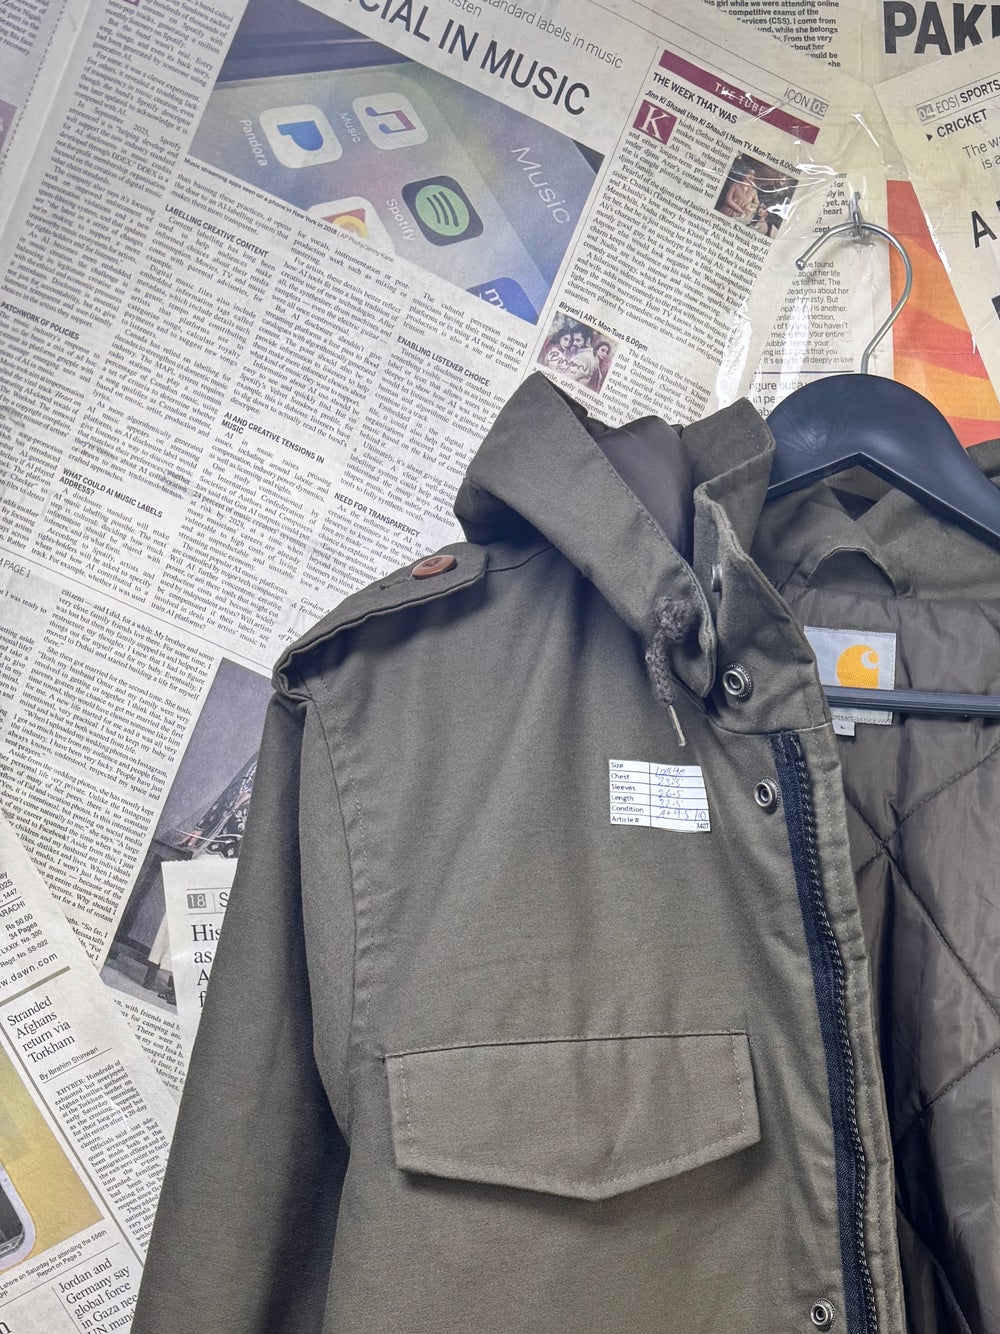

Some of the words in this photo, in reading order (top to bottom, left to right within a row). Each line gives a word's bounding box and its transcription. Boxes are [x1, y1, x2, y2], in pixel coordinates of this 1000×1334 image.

[535, 14, 572, 43] labels
[572, 32, 585, 49] in
[585, 42, 624, 69] music
[774, 26, 795, 34] while
[795, 26, 809, 34] she
[809, 26, 839, 35] belongs
[438, 18, 480, 62] IN
[479, 39, 590, 116] MUSIC
[652, 71, 671, 88] THE
[670, 81, 696, 102] WEEK
[696, 95, 720, 114] THAT
[718, 107, 738, 124] WAS
[341, 112, 361, 144] Music
[936, 107, 987, 138] CRICKET
[238, 118, 269, 168] Pandora
[510, 146, 570, 224] Music
[164, 203, 203, 227] LABELLING
[202, 222, 236, 243] CREATIVE
[235, 237, 269, 258] CONTENT
[386, 197, 415, 241] Spotify
[971, 210, 998, 249] A
[58, 475, 95, 496] ADDRESS?
[62, 467, 83, 481] WHAT
[82, 476, 106, 492] COULD
[105, 487, 114, 496] AI
[113, 490, 137, 506] MUSIC
[136, 501, 163, 519] LABELS
[611, 772, 630, 780] Chest
[612, 783, 636, 792] Sleeves
[612, 795, 634, 803] Length
[612, 805, 644, 813] Condition
[6, 996, 53, 1027] Stranded
[16, 1011, 58, 1040] Afghans
[22, 1030, 53, 1052] return
[52, 1021, 72, 1034] via
[27, 1035, 76, 1063] Torkham
[58, 1271, 93, 1294] Jordan
[92, 1257, 113, 1275] and
[65, 1275, 112, 1305] Germany
[113, 1265, 130, 1281] say
[74, 1293, 106, 1319] global
[104, 1282, 132, 1301] force
[81, 1319, 94, 1330] in
[92, 1304, 121, 1323] Gaza
